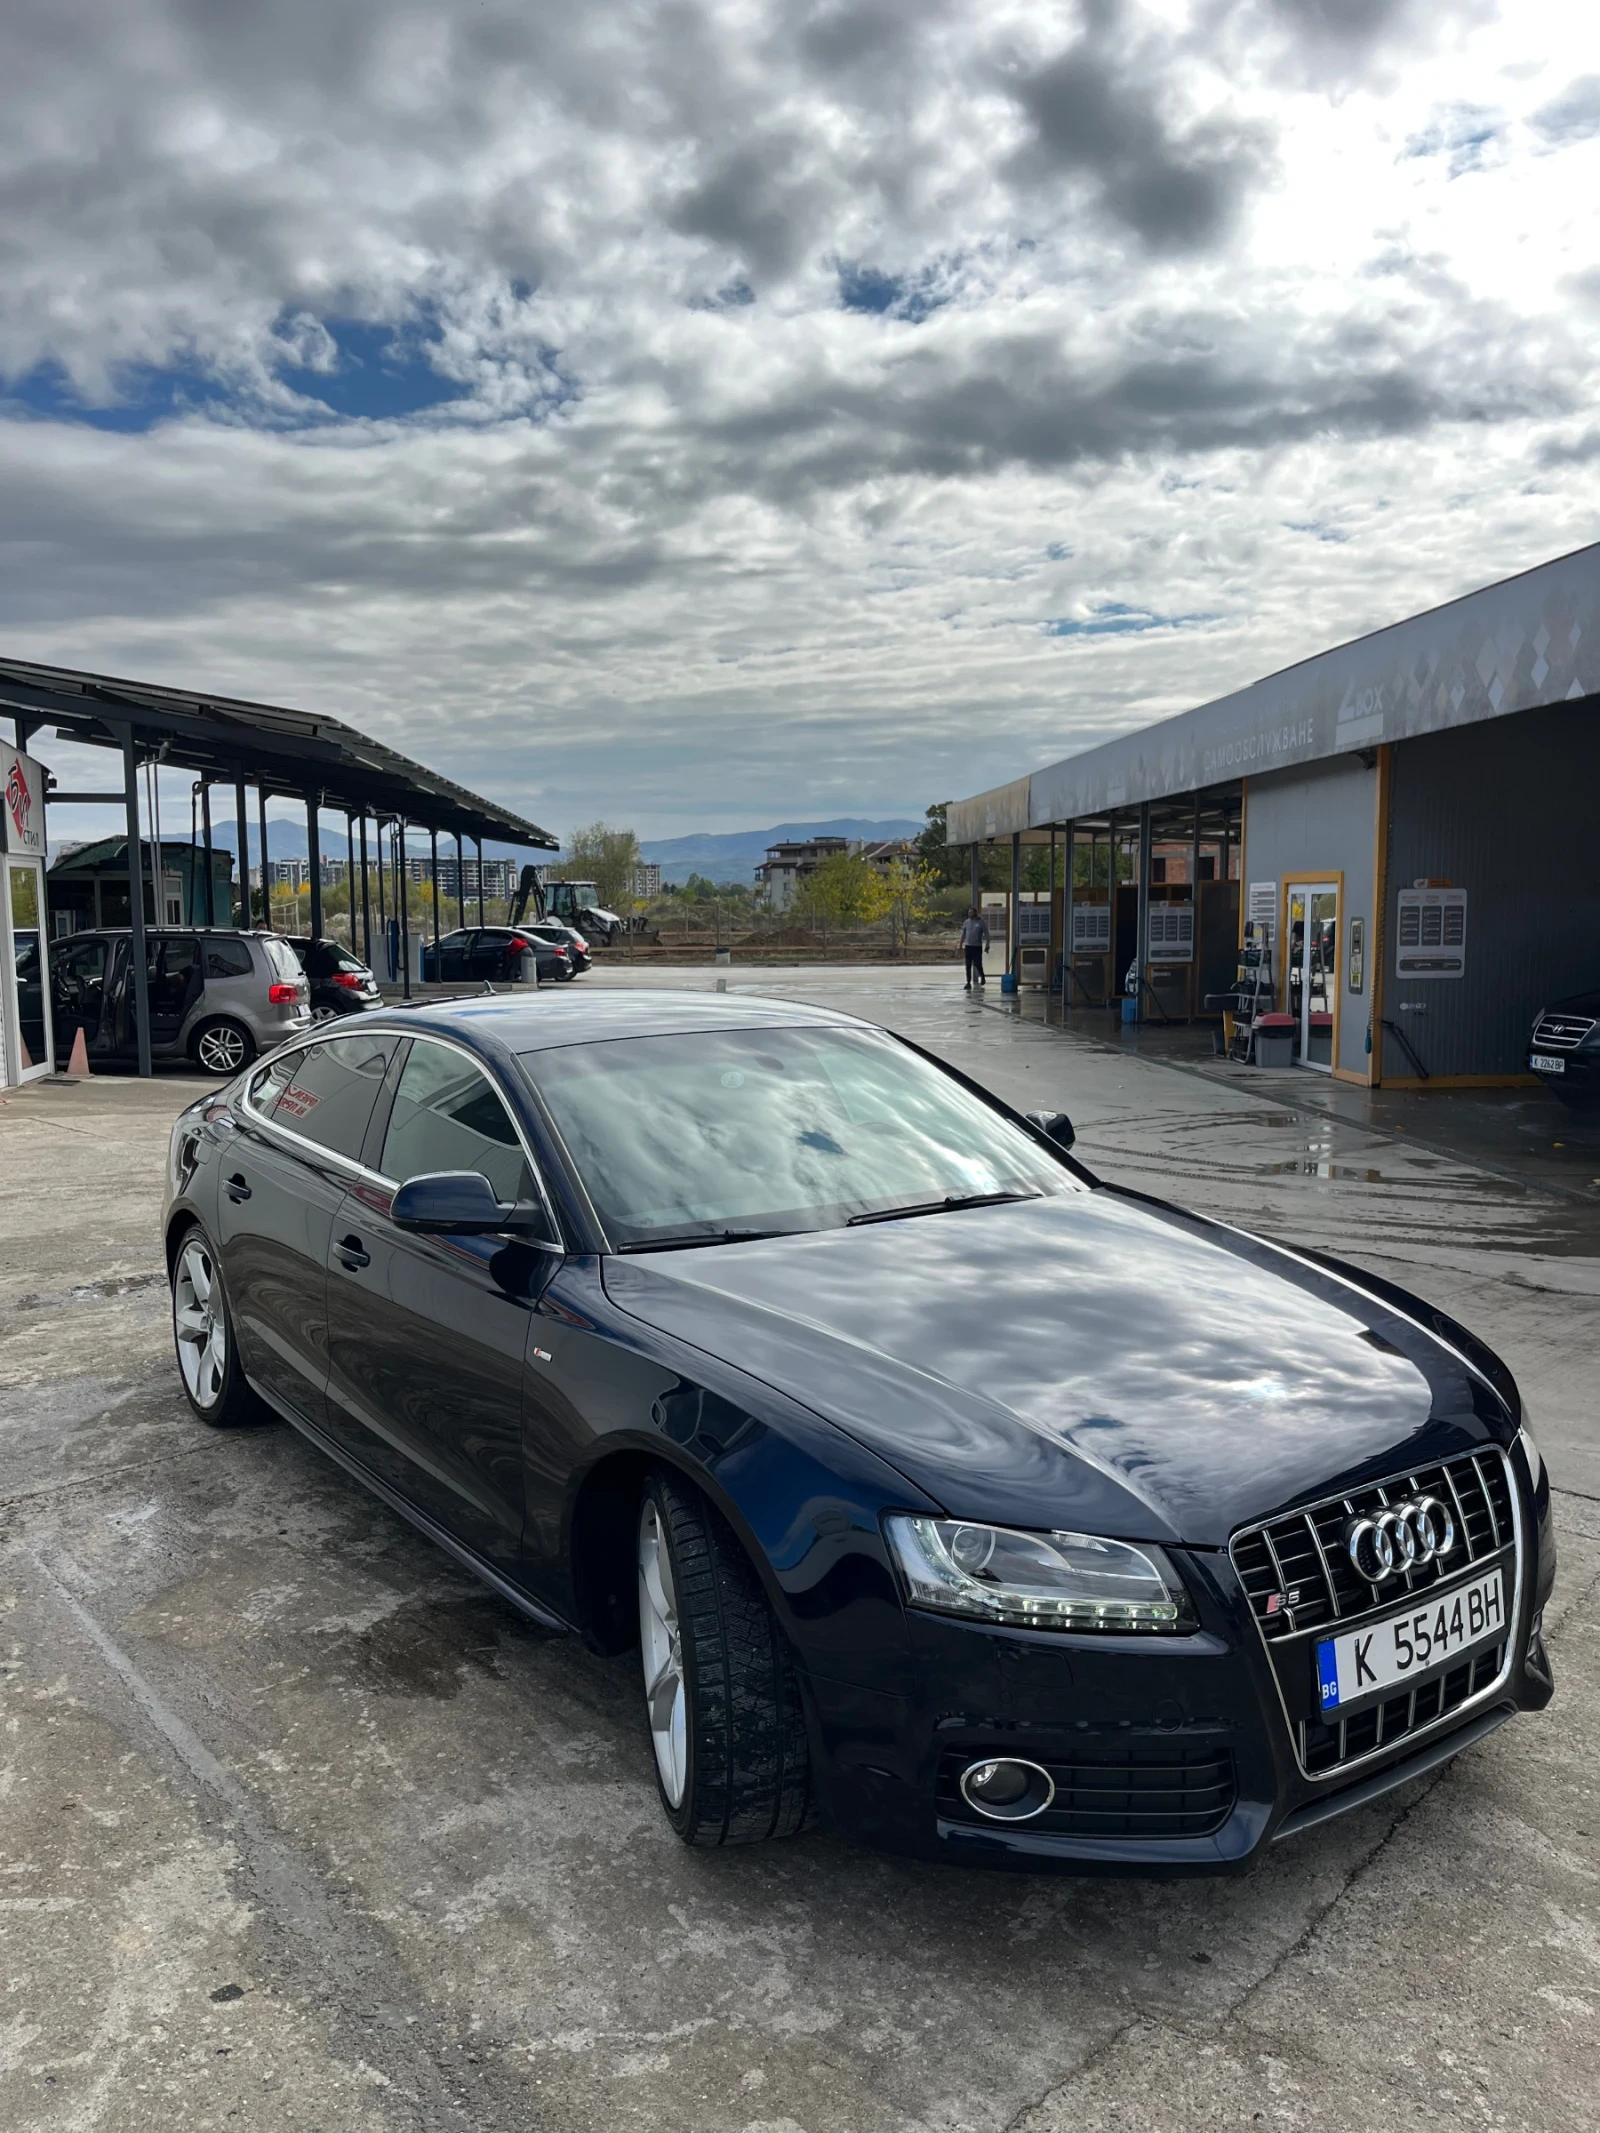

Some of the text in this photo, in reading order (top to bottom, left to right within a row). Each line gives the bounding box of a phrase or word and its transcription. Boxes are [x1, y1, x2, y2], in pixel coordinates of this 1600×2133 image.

[1203, 718, 1314, 771] САМООБСЛУЖВАНЕ
[23, 829, 39, 848] СТИЛ
[1275, 1590, 1300, 1607] S5
[1354, 1577, 1500, 1687] K 5544 BH
[1322, 1681, 1338, 1699] BG
